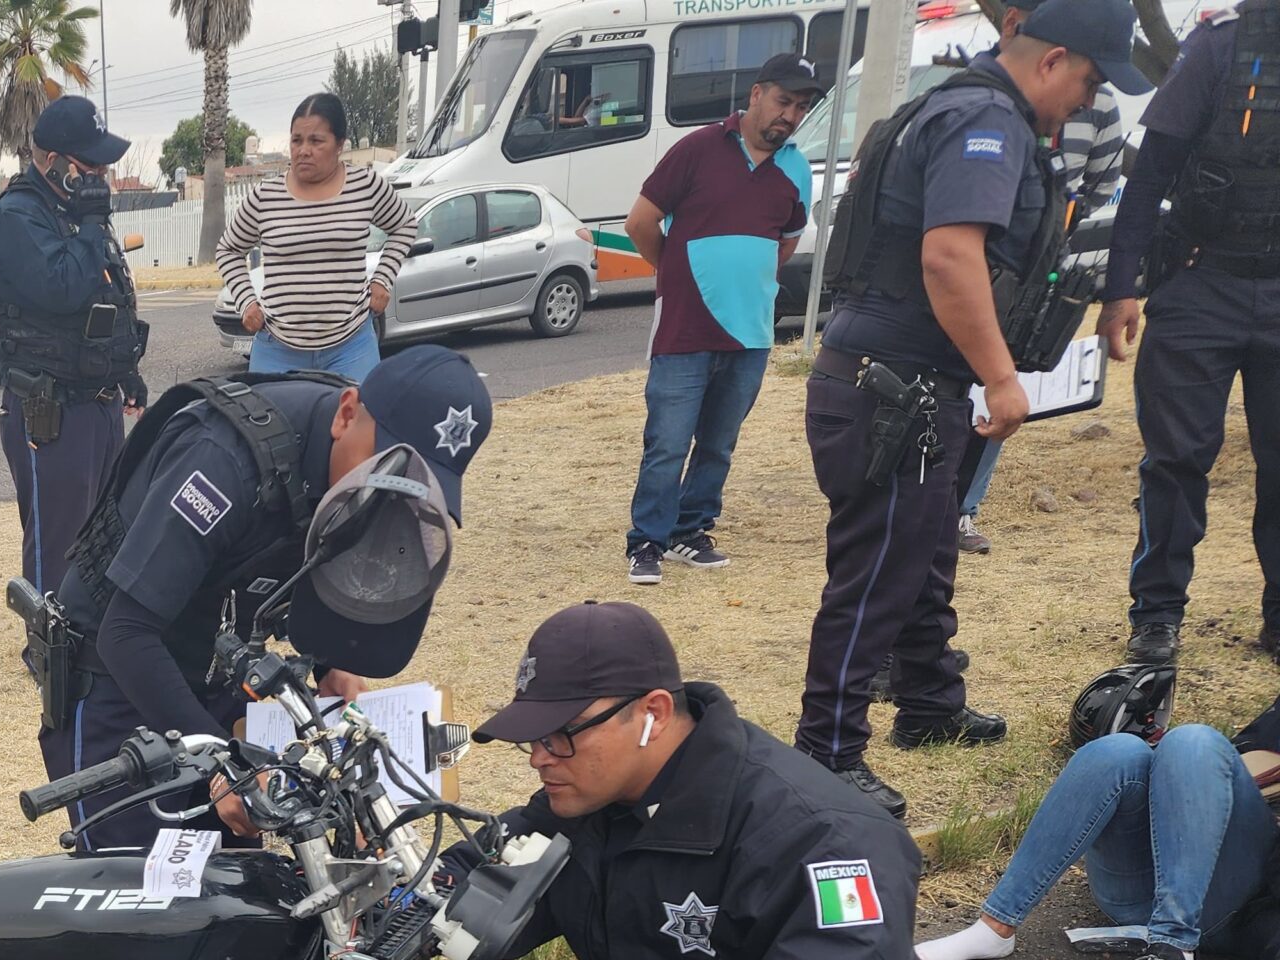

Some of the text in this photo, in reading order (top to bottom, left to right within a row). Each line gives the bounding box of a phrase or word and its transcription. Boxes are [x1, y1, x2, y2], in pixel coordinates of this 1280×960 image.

[594, 31, 643, 42] Boxer
[181, 488, 213, 524] SOCIAL
[186, 482, 220, 516] PROXIMIDAD
[815, 865, 867, 880] MÉXICO
